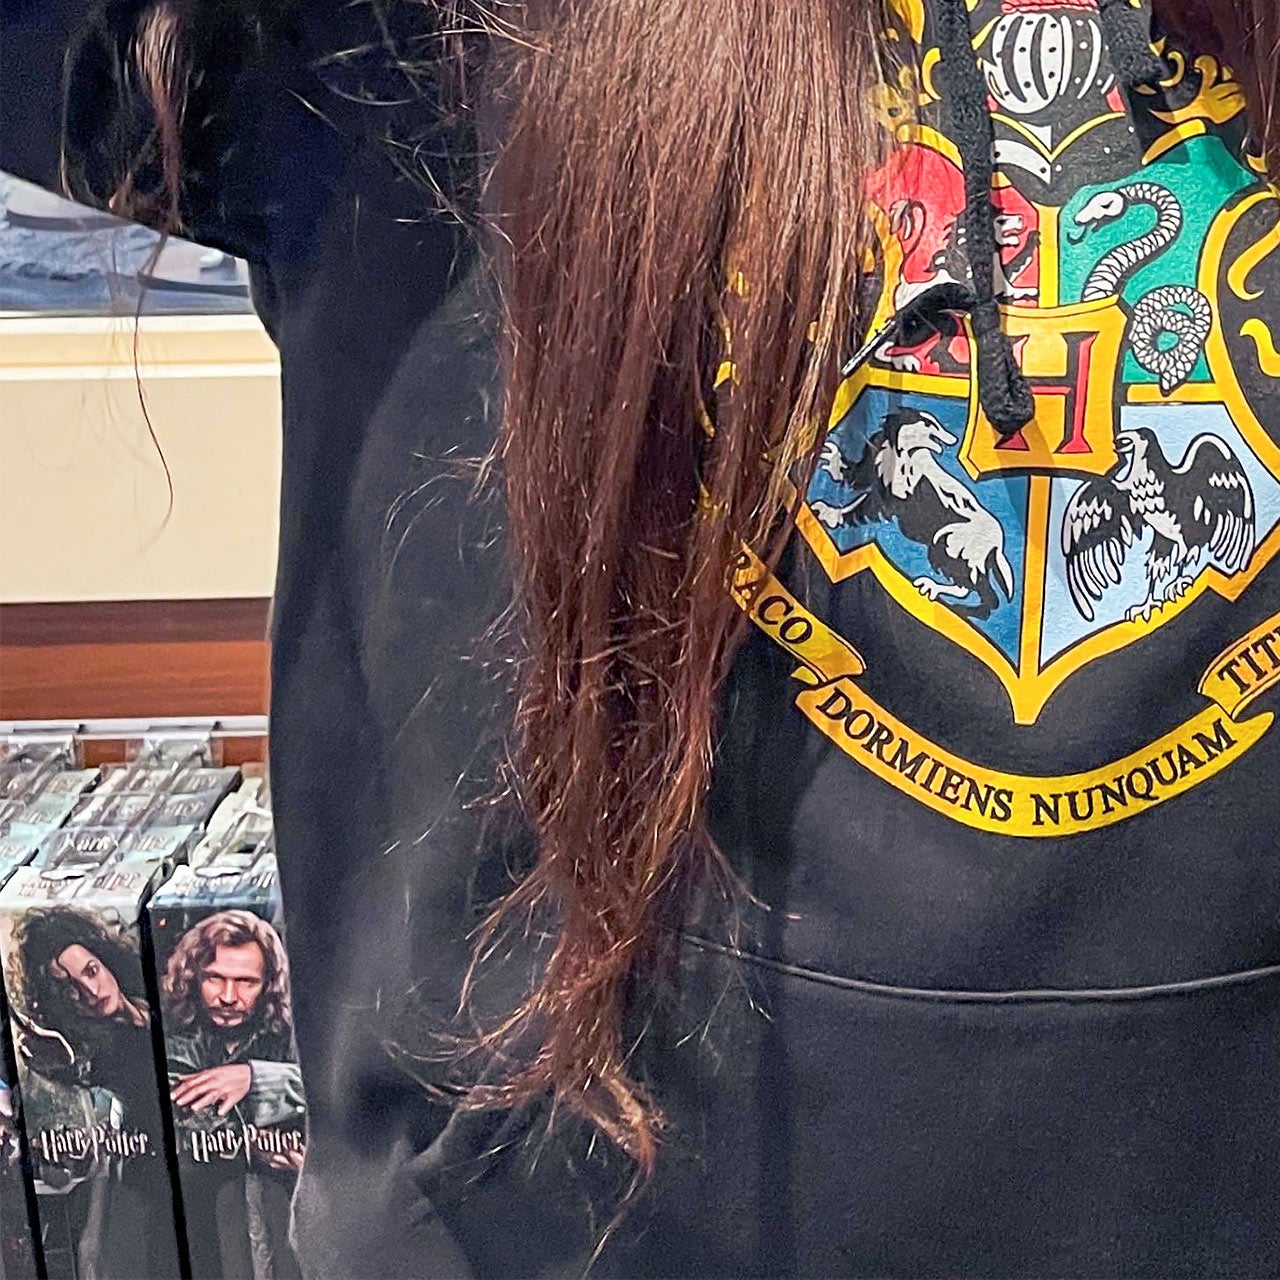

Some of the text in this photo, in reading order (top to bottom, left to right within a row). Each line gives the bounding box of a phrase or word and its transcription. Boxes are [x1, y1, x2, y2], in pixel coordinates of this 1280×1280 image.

[816, 687, 1013, 824] DORMIENS
[1032, 718, 1238, 826] NUNQUAM
[40, 1122, 149, 1163] Harry Potter
[191, 1123, 304, 1164] Harry Potter
